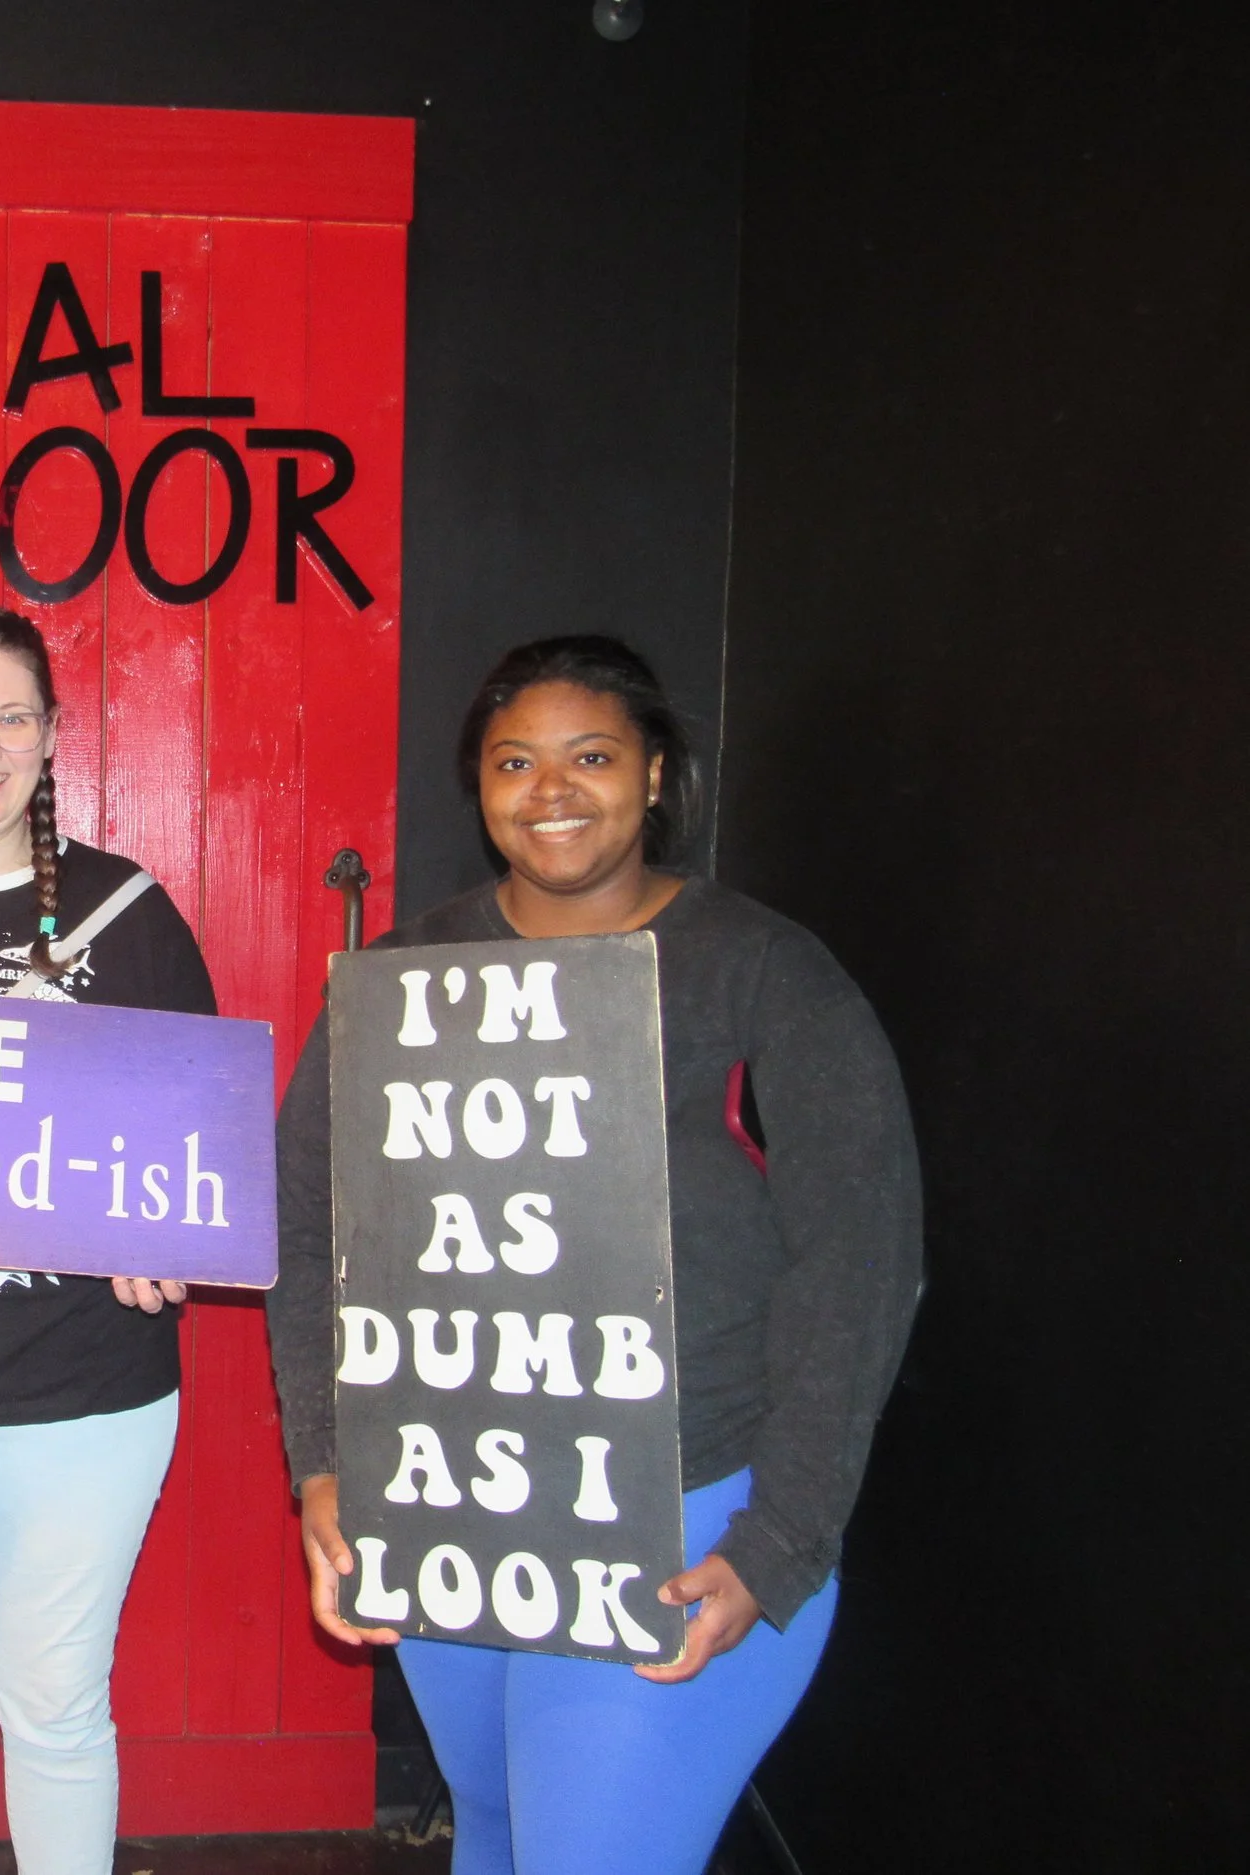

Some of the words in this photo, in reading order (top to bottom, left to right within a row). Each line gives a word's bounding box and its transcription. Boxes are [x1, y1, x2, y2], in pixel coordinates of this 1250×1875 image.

[397, 961, 567, 1047] I'M
[382, 1075, 591, 1160] NOT
[417, 1192, 560, 1275] AS
[337, 1306, 665, 1400] DUMB
[384, 1423, 530, 1513] AS
[572, 1436, 619, 1522] I
[354, 1537, 660, 1653] LOOK
